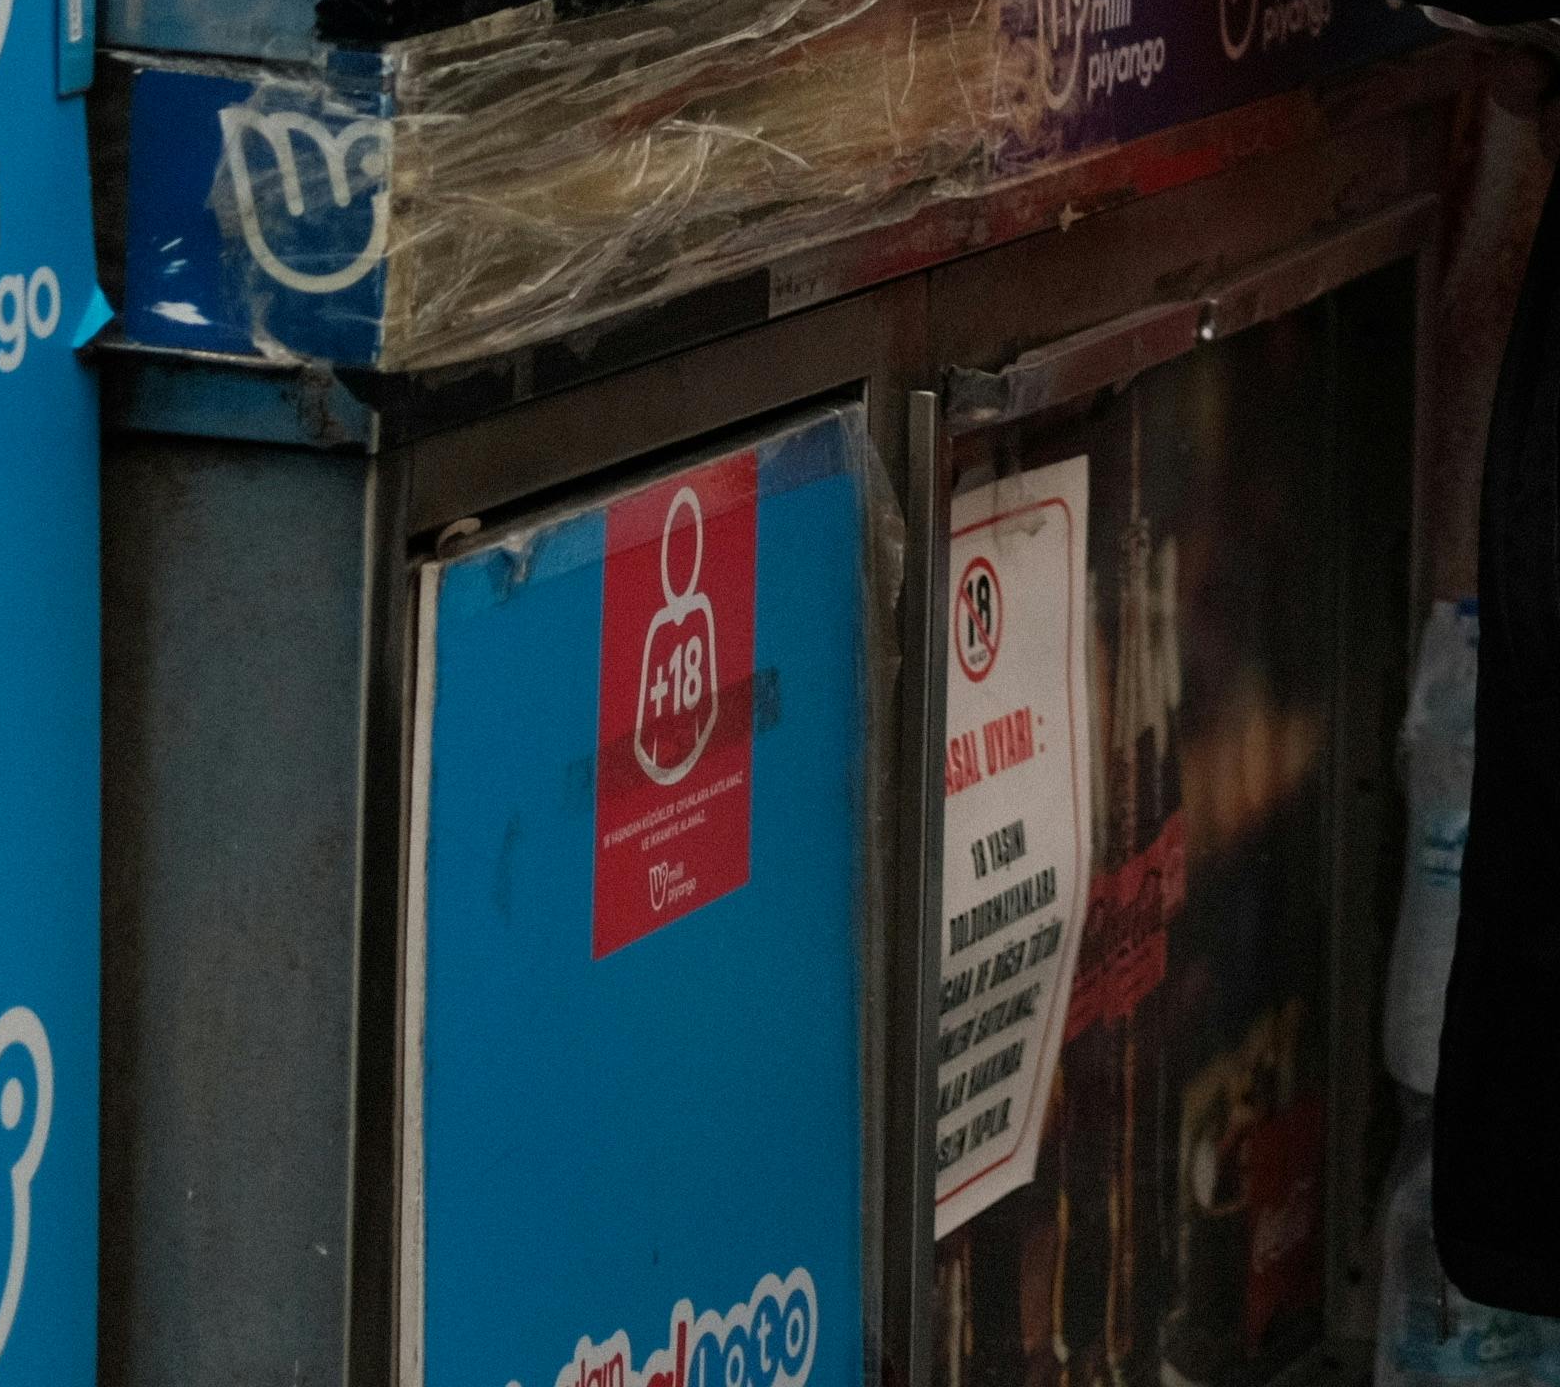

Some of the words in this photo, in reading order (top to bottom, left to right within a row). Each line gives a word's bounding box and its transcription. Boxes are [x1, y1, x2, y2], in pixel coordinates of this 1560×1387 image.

[1088, 36, 1166, 103] piyango
[650, 635, 703, 717] +18
[983, 706, 1035, 777] UYARI
